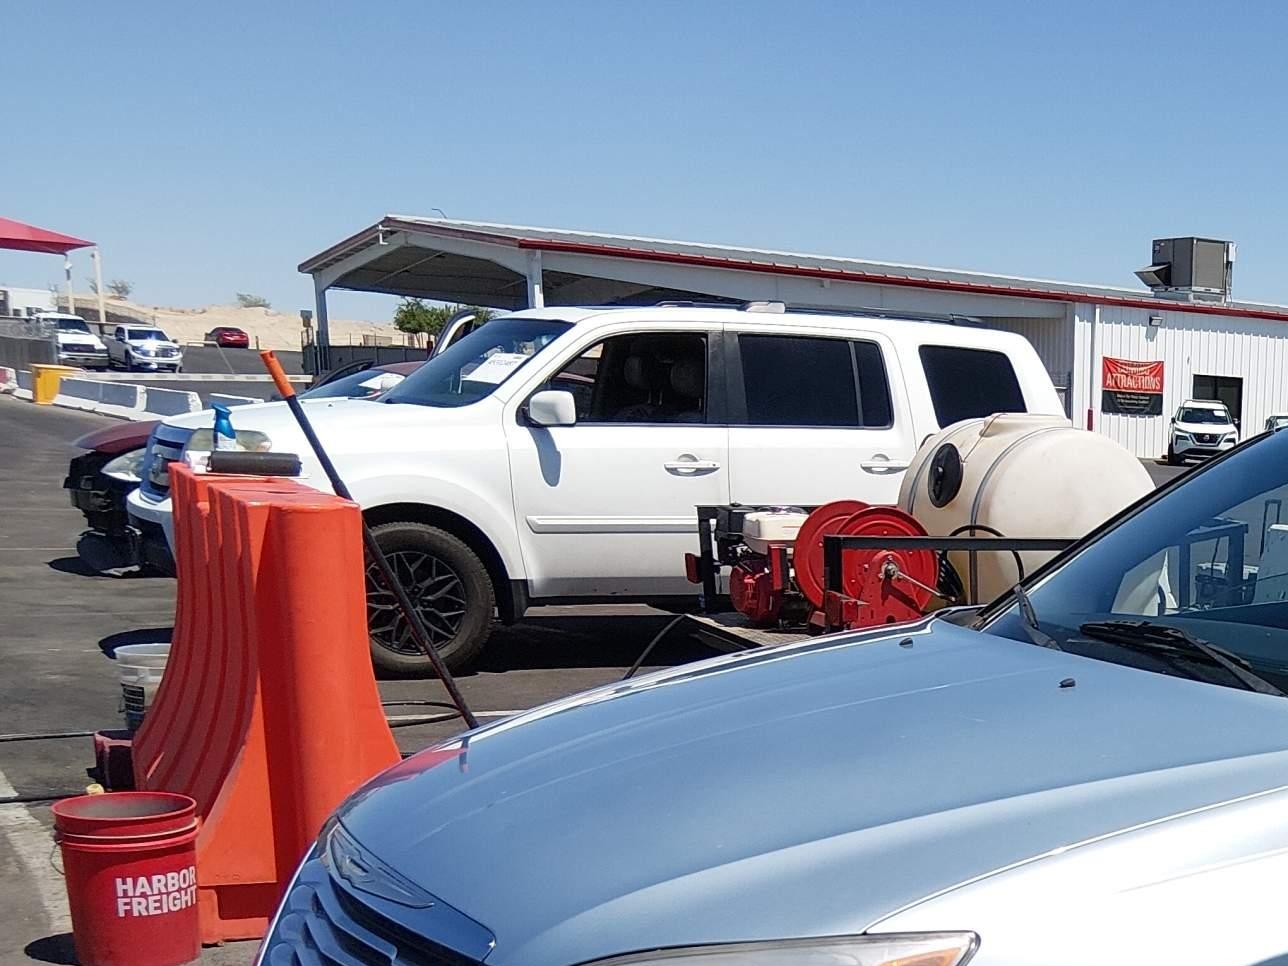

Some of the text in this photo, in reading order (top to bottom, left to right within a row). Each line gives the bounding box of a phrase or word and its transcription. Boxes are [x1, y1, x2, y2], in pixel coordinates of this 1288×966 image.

[1105, 372, 1161, 390] ATTRACTIONS
[115, 865, 197, 897] HARBOR
[117, 885, 198, 918] FREIGHT
